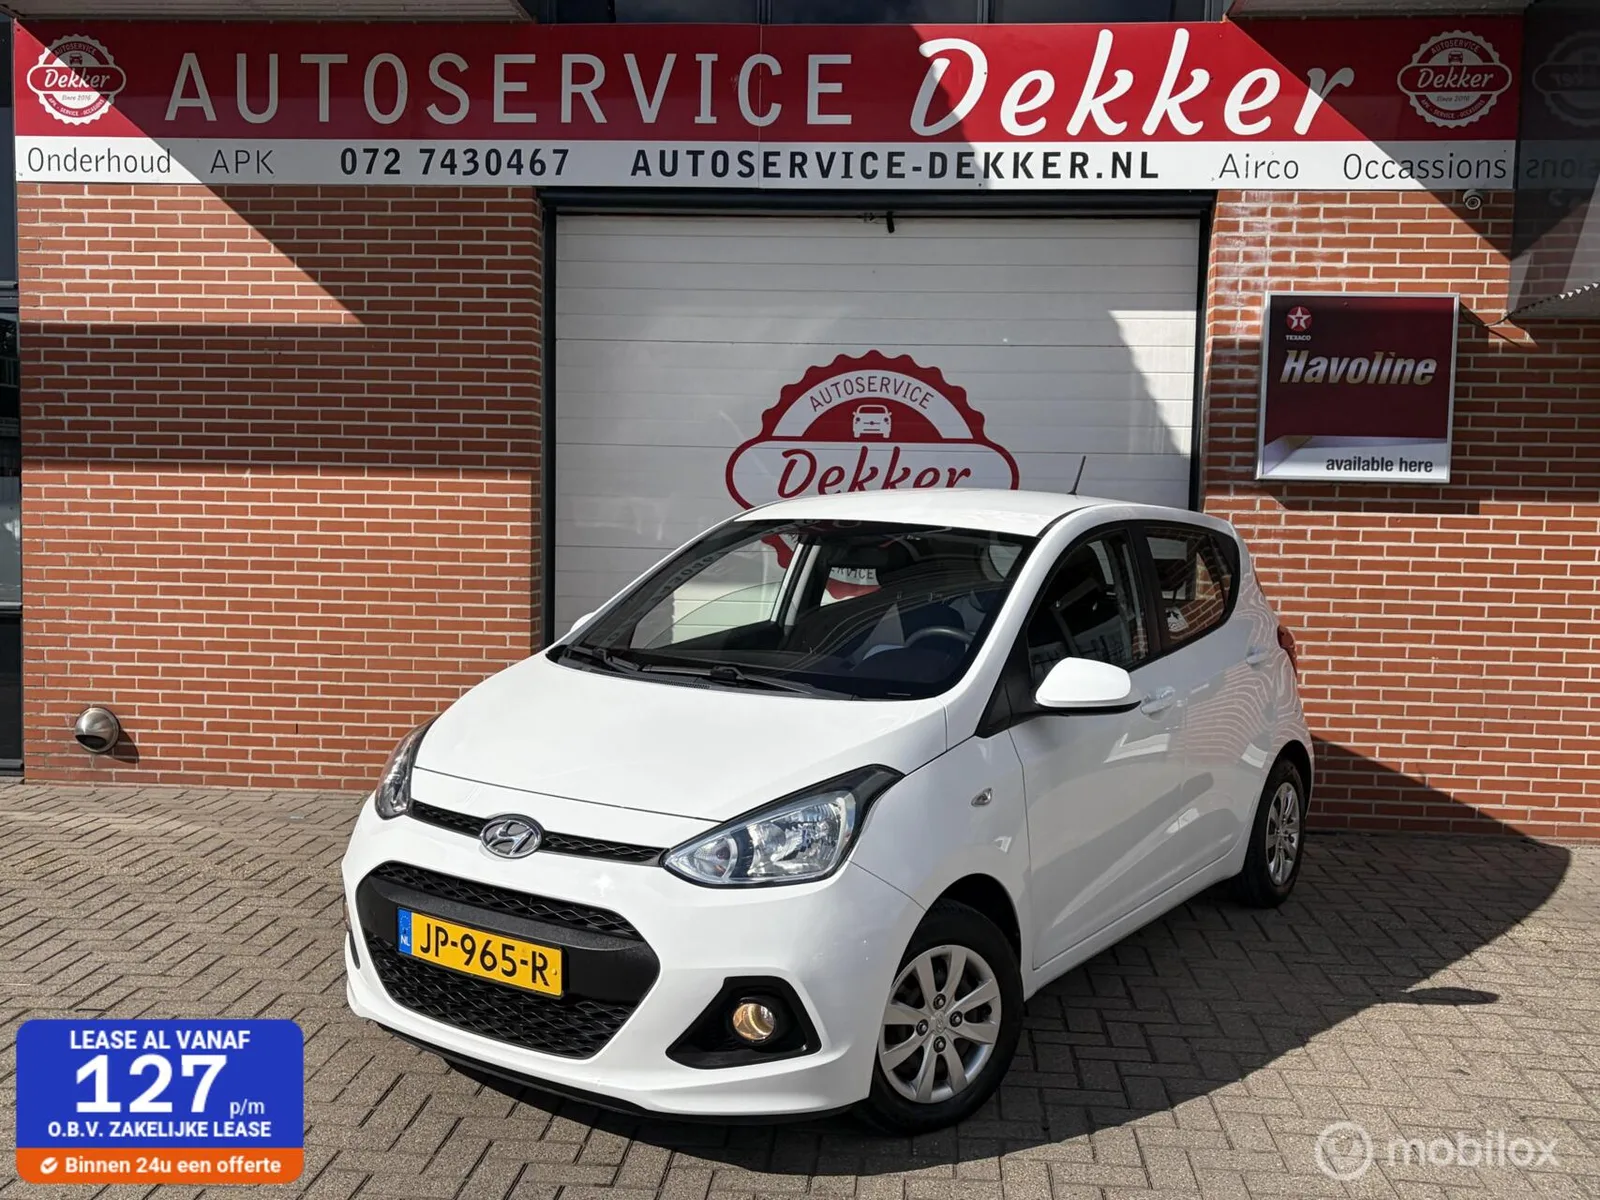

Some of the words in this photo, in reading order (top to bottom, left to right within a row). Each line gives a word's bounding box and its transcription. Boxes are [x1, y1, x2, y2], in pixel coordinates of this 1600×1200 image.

[1431, 39, 1481, 55] AUTOSERVICE
[44, 67, 111, 88] Dekker
[164, 52, 852, 126] AUTOSERVICE
[910, 28, 1354, 136] Dekker
[1417, 66, 1494, 88] Dekker
[28, 147, 171, 173] Onderhoud
[210, 149, 274, 174] APK
[340, 147, 401, 175] 072
[419, 148, 570, 176] 7430467
[631, 150, 1159, 180] AUTOSERVICE-DEKKER.NL
[1219, 153, 1299, 180] Airco
[1343, 153, 1507, 181] Occassions
[1280, 350, 1437, 386] Havoline
[809, 376, 934, 412] AUTOSERVICE
[777, 446, 972, 499] Dekker
[1326, 456, 1394, 472] available
[1399, 457, 1433, 473] here
[400, 935, 411, 947] NL
[420, 923, 550, 987] JP-965-R
